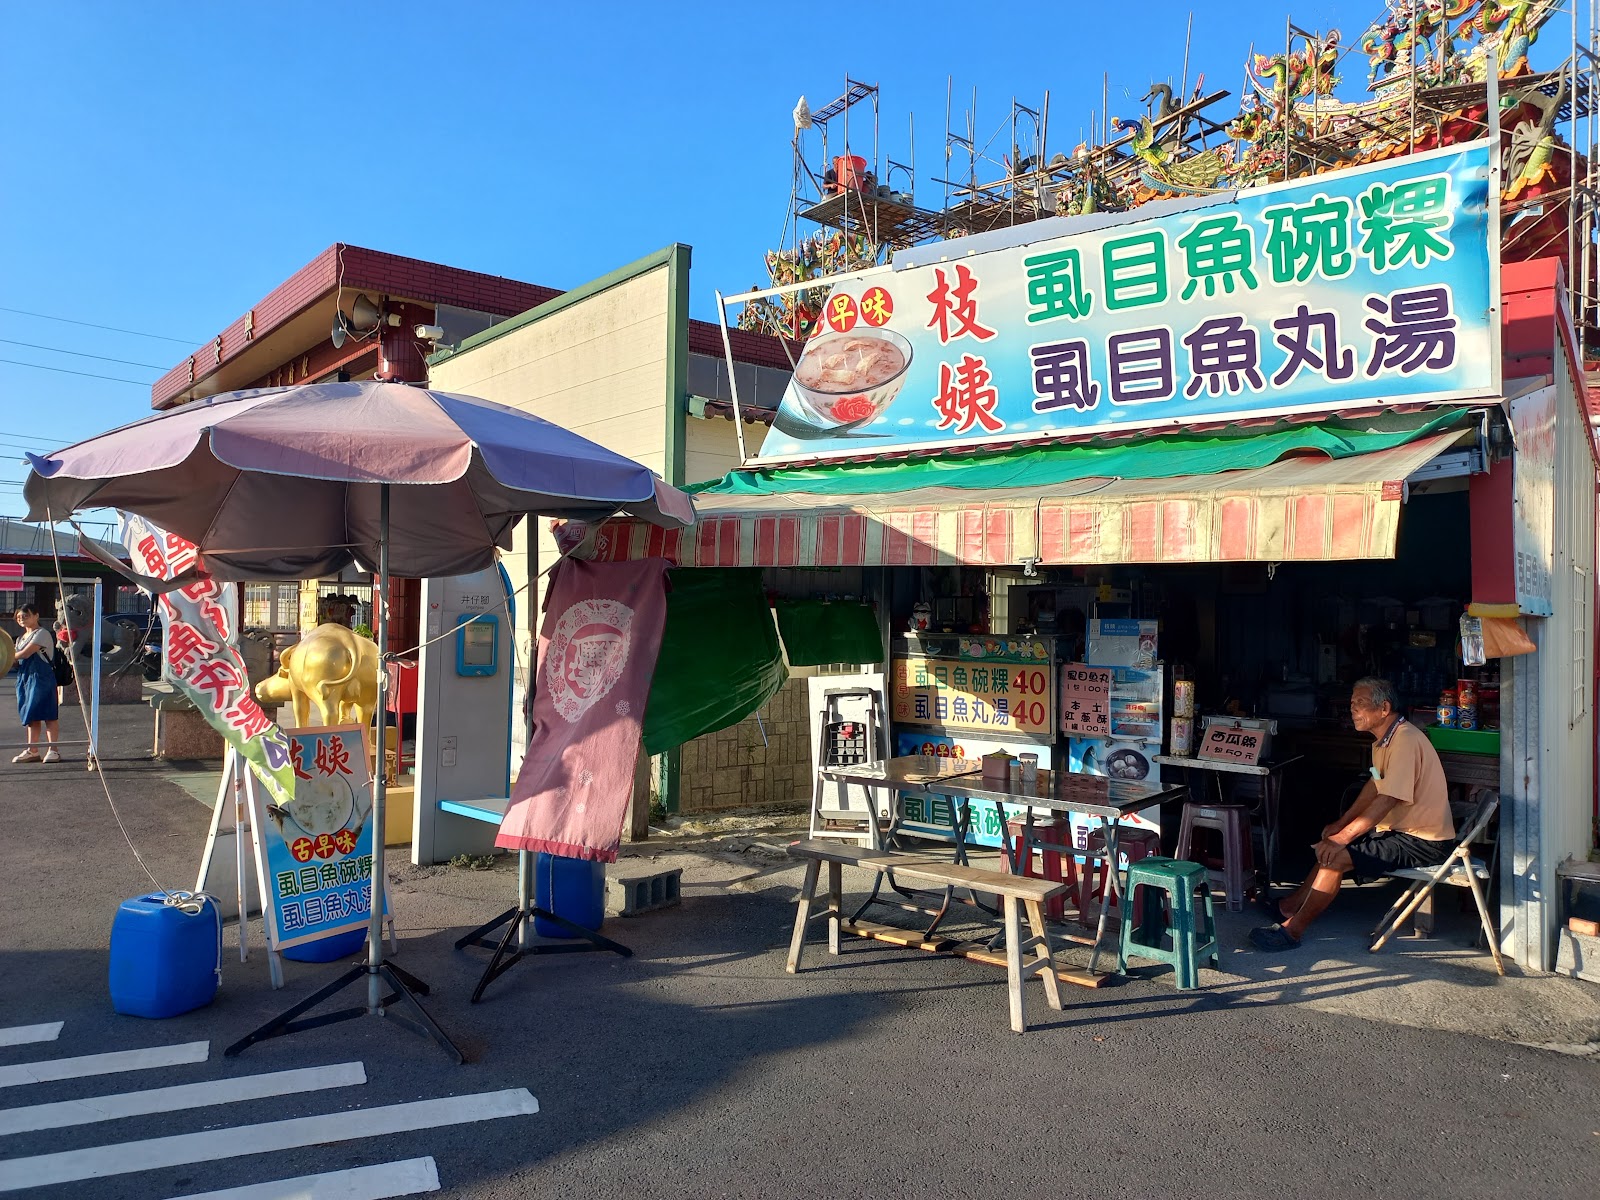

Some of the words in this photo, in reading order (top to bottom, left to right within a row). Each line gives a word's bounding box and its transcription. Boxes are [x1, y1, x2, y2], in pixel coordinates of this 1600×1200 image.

[1025, 177, 1450, 323] 虱目魚碗粿
[811, 288, 892, 336] 早味
[926, 264, 1004, 432] 枝姨
[1030, 288, 1457, 410] 虱目魚丸湯
[914, 665, 1009, 694] 虱目魚碗粿
[1012, 670, 1046, 695] 40
[914, 694, 1009, 725] 虱目魚丸湯
[1012, 700, 1045, 726] 40
[1071, 701, 1102, 713] 本土
[922, 742, 964, 759] 古早味
[904, 796, 1021, 836] 虱目魚碗
[293, 830, 356, 861] 古早味
[277, 856, 372, 898] 虱目魚碗粿
